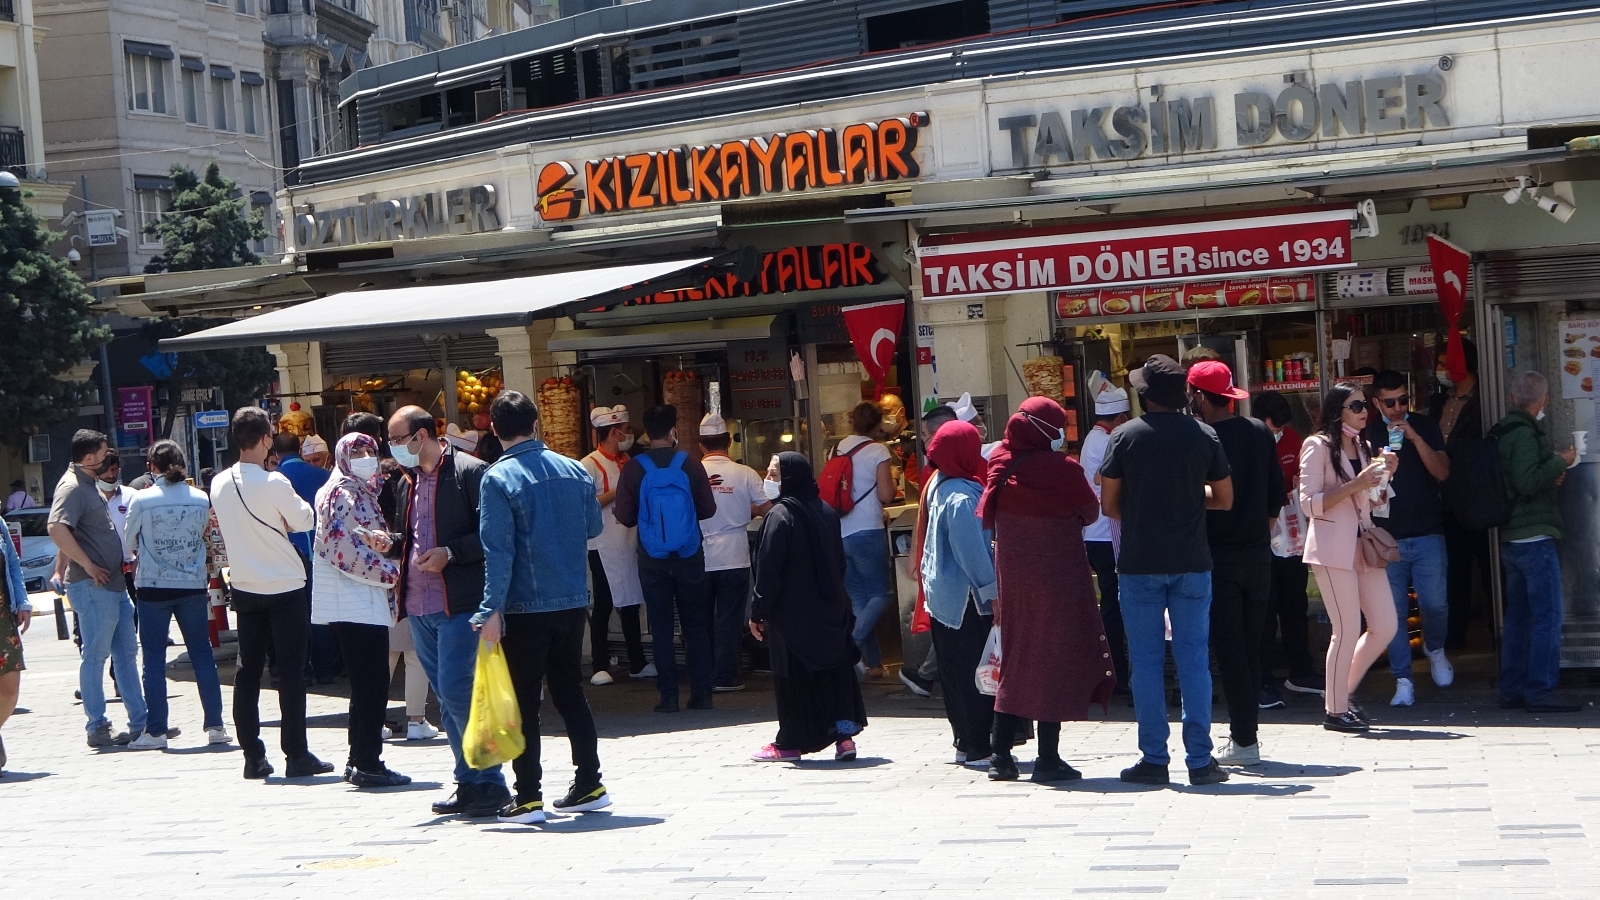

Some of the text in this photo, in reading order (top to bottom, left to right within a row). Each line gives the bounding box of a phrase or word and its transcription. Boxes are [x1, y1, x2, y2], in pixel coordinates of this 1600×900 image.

[998, 70, 1452, 169] TAKSİM DÖNER
[584, 117, 920, 214] KIZILKAYALAR
[294, 183, 500, 250] ÖZTÜRKLER
[924, 236, 1345, 294] TAKSİM DÖNER since 1934
[1262, 381, 1306, 392] KALİTENİN
